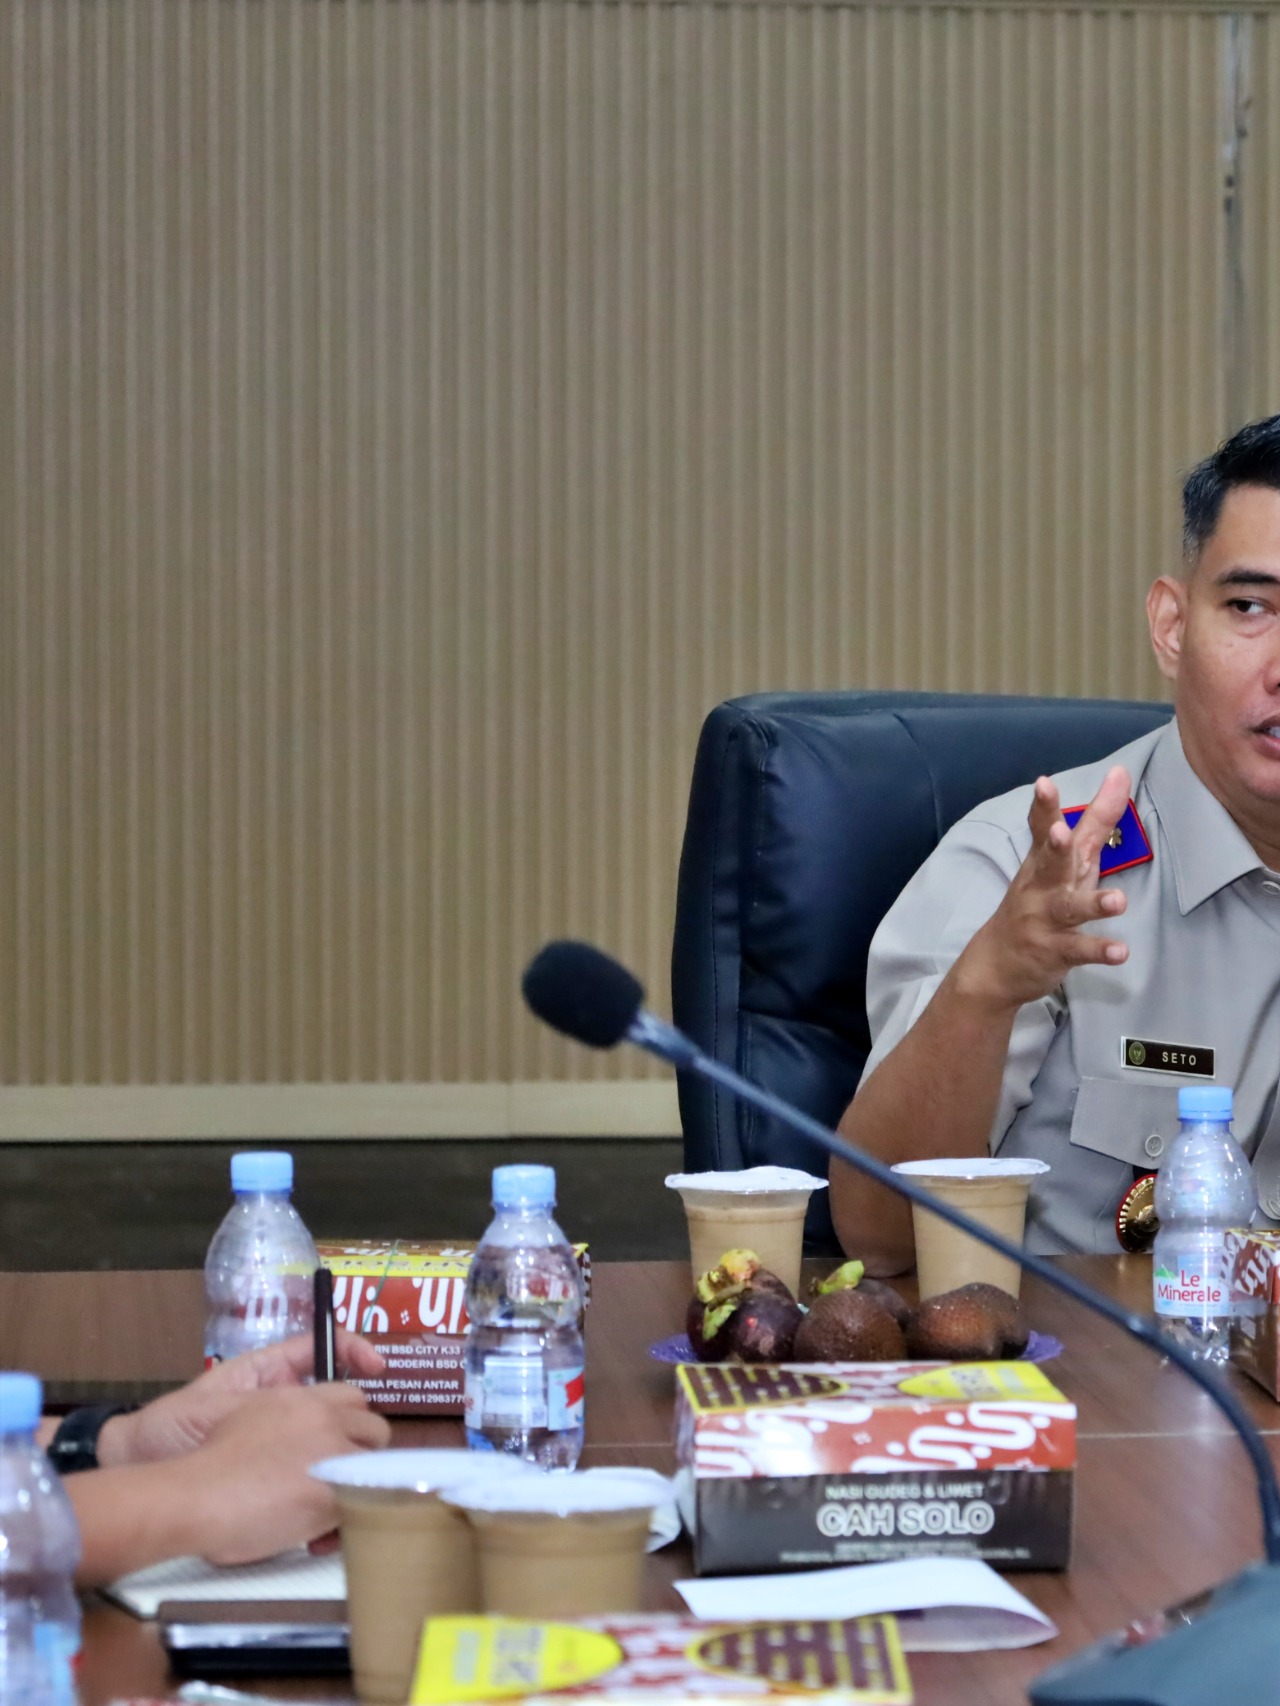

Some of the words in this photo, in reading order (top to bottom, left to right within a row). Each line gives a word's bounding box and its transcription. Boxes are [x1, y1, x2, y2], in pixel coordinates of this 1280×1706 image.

[1162, 1051, 1196, 1066] SETO
[1181, 1270, 1200, 1287] Le
[1158, 1284, 1221, 1302] Minerale
[391, 1345, 413, 1355] BSD
[415, 1345, 439, 1355] CITY
[440, 1345, 461, 1355] K33
[388, 1359, 434, 1369] MODERN
[436, 1359, 457, 1369] BSD
[386, 1380, 421, 1390] PESAN
[423, 1380, 459, 1390] ANTAR
[816, 1501, 895, 1537] CAH
[897, 1500, 995, 1536] SOLO
